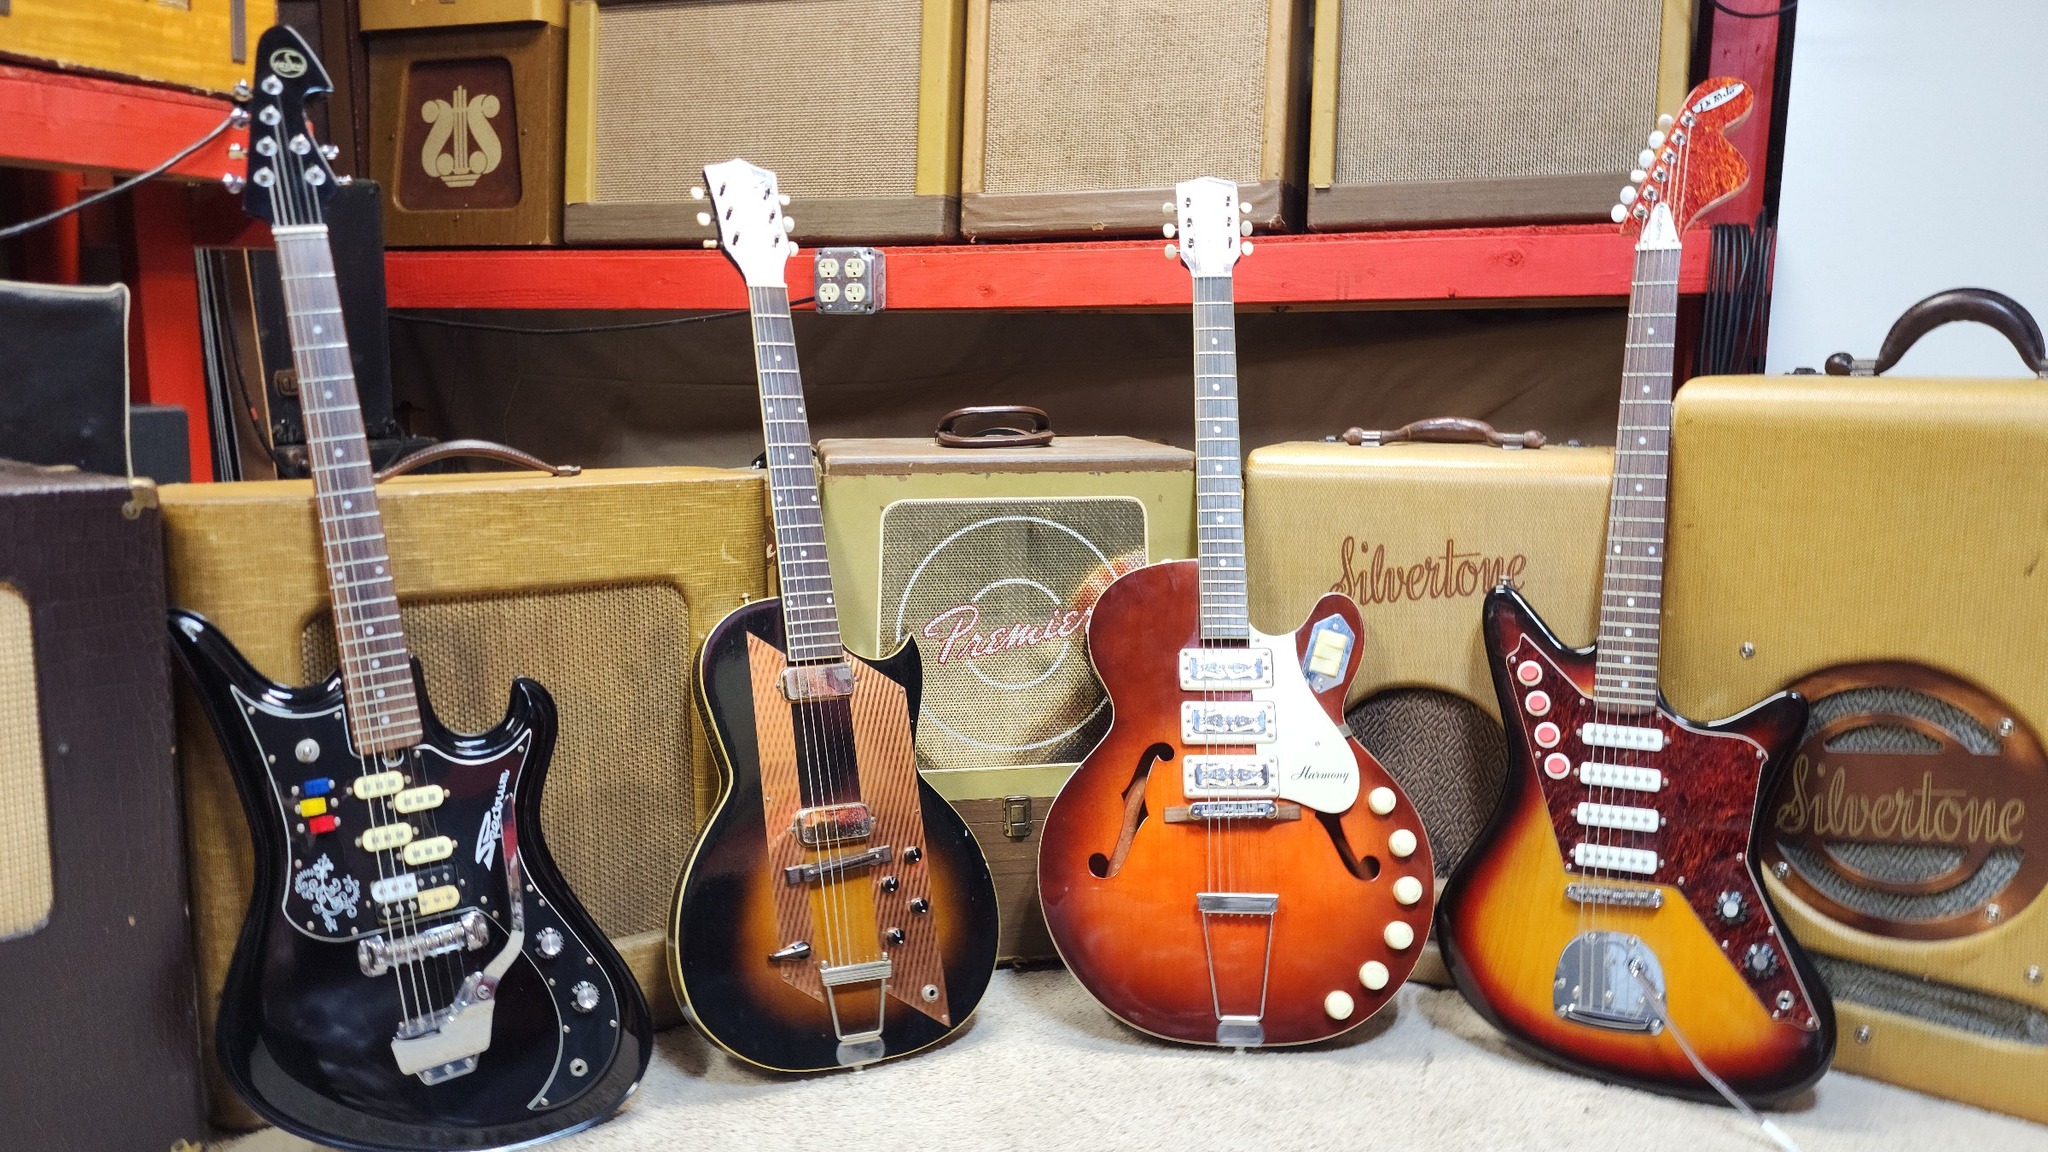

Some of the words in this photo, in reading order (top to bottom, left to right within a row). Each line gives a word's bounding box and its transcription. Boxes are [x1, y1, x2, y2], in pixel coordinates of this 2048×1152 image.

[1329, 536, 1527, 605] Silvertone
[1291, 765, 1350, 783] Harmony
[1775, 754, 2025, 843] Silvertone
